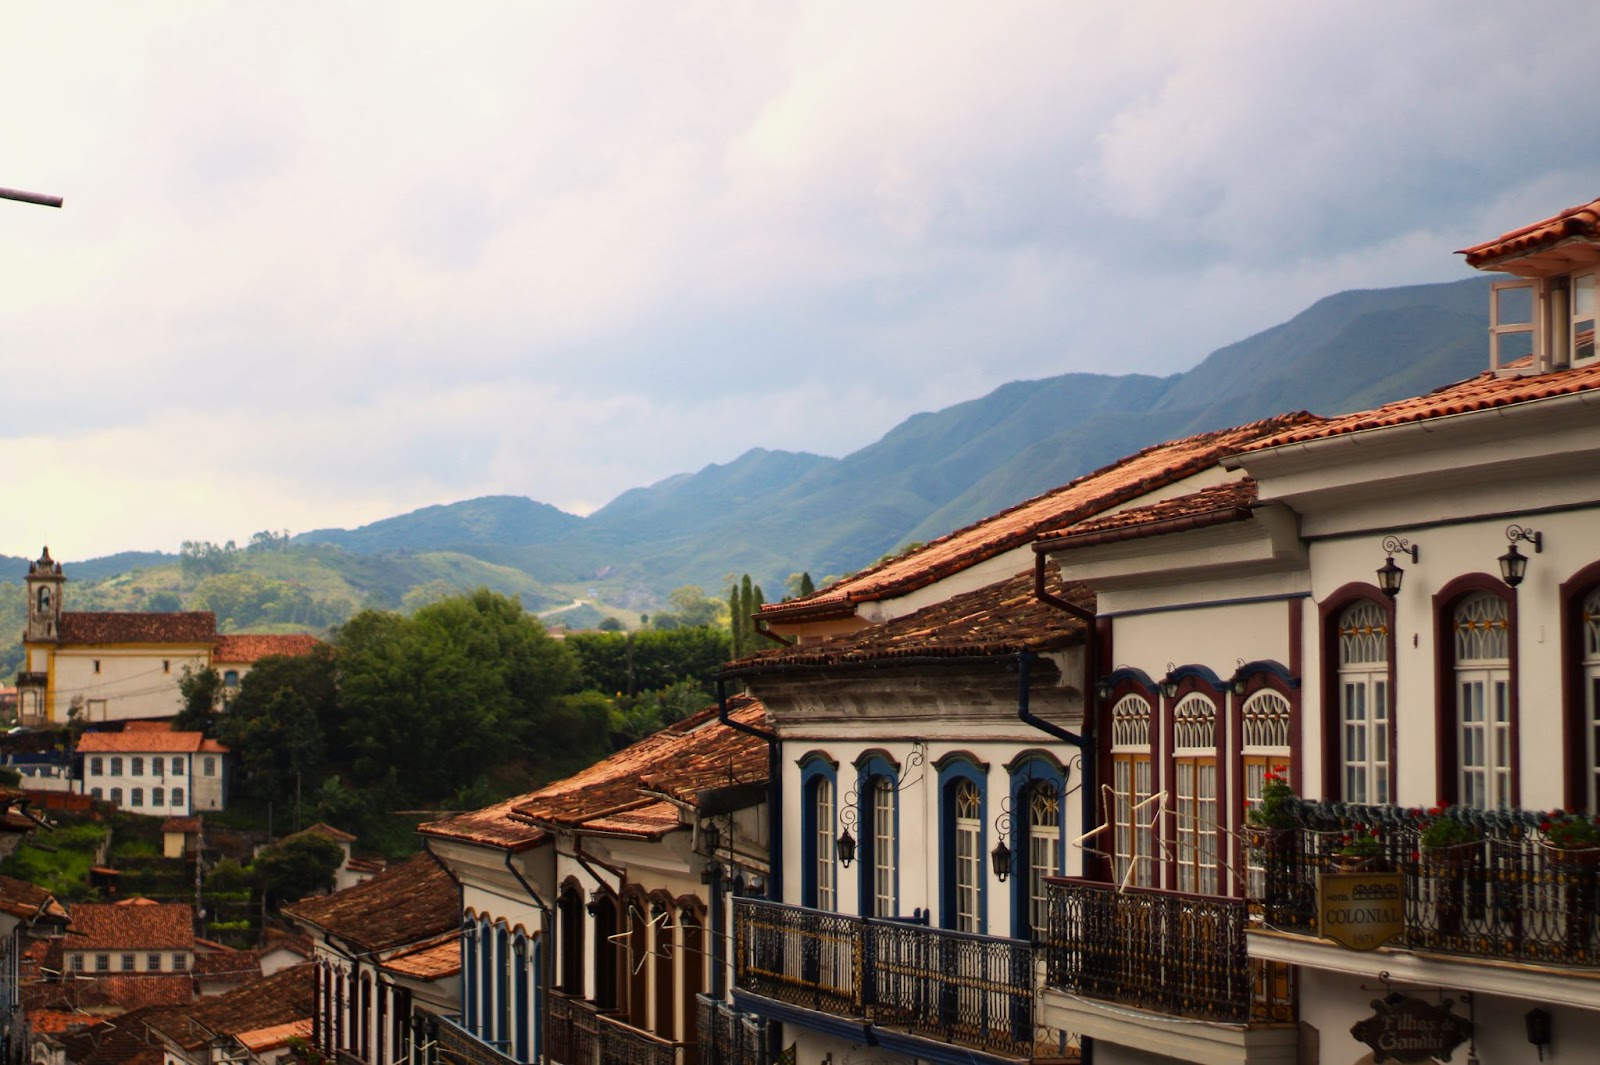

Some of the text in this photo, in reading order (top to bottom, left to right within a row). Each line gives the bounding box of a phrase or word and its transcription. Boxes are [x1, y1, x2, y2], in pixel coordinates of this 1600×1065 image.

[1326, 894, 1349, 902] HOTEL
[1326, 908, 1400, 925] COLONIAL
[1381, 1013, 1436, 1031] Filhos
[1378, 1031, 1444, 1051] Gandhi
